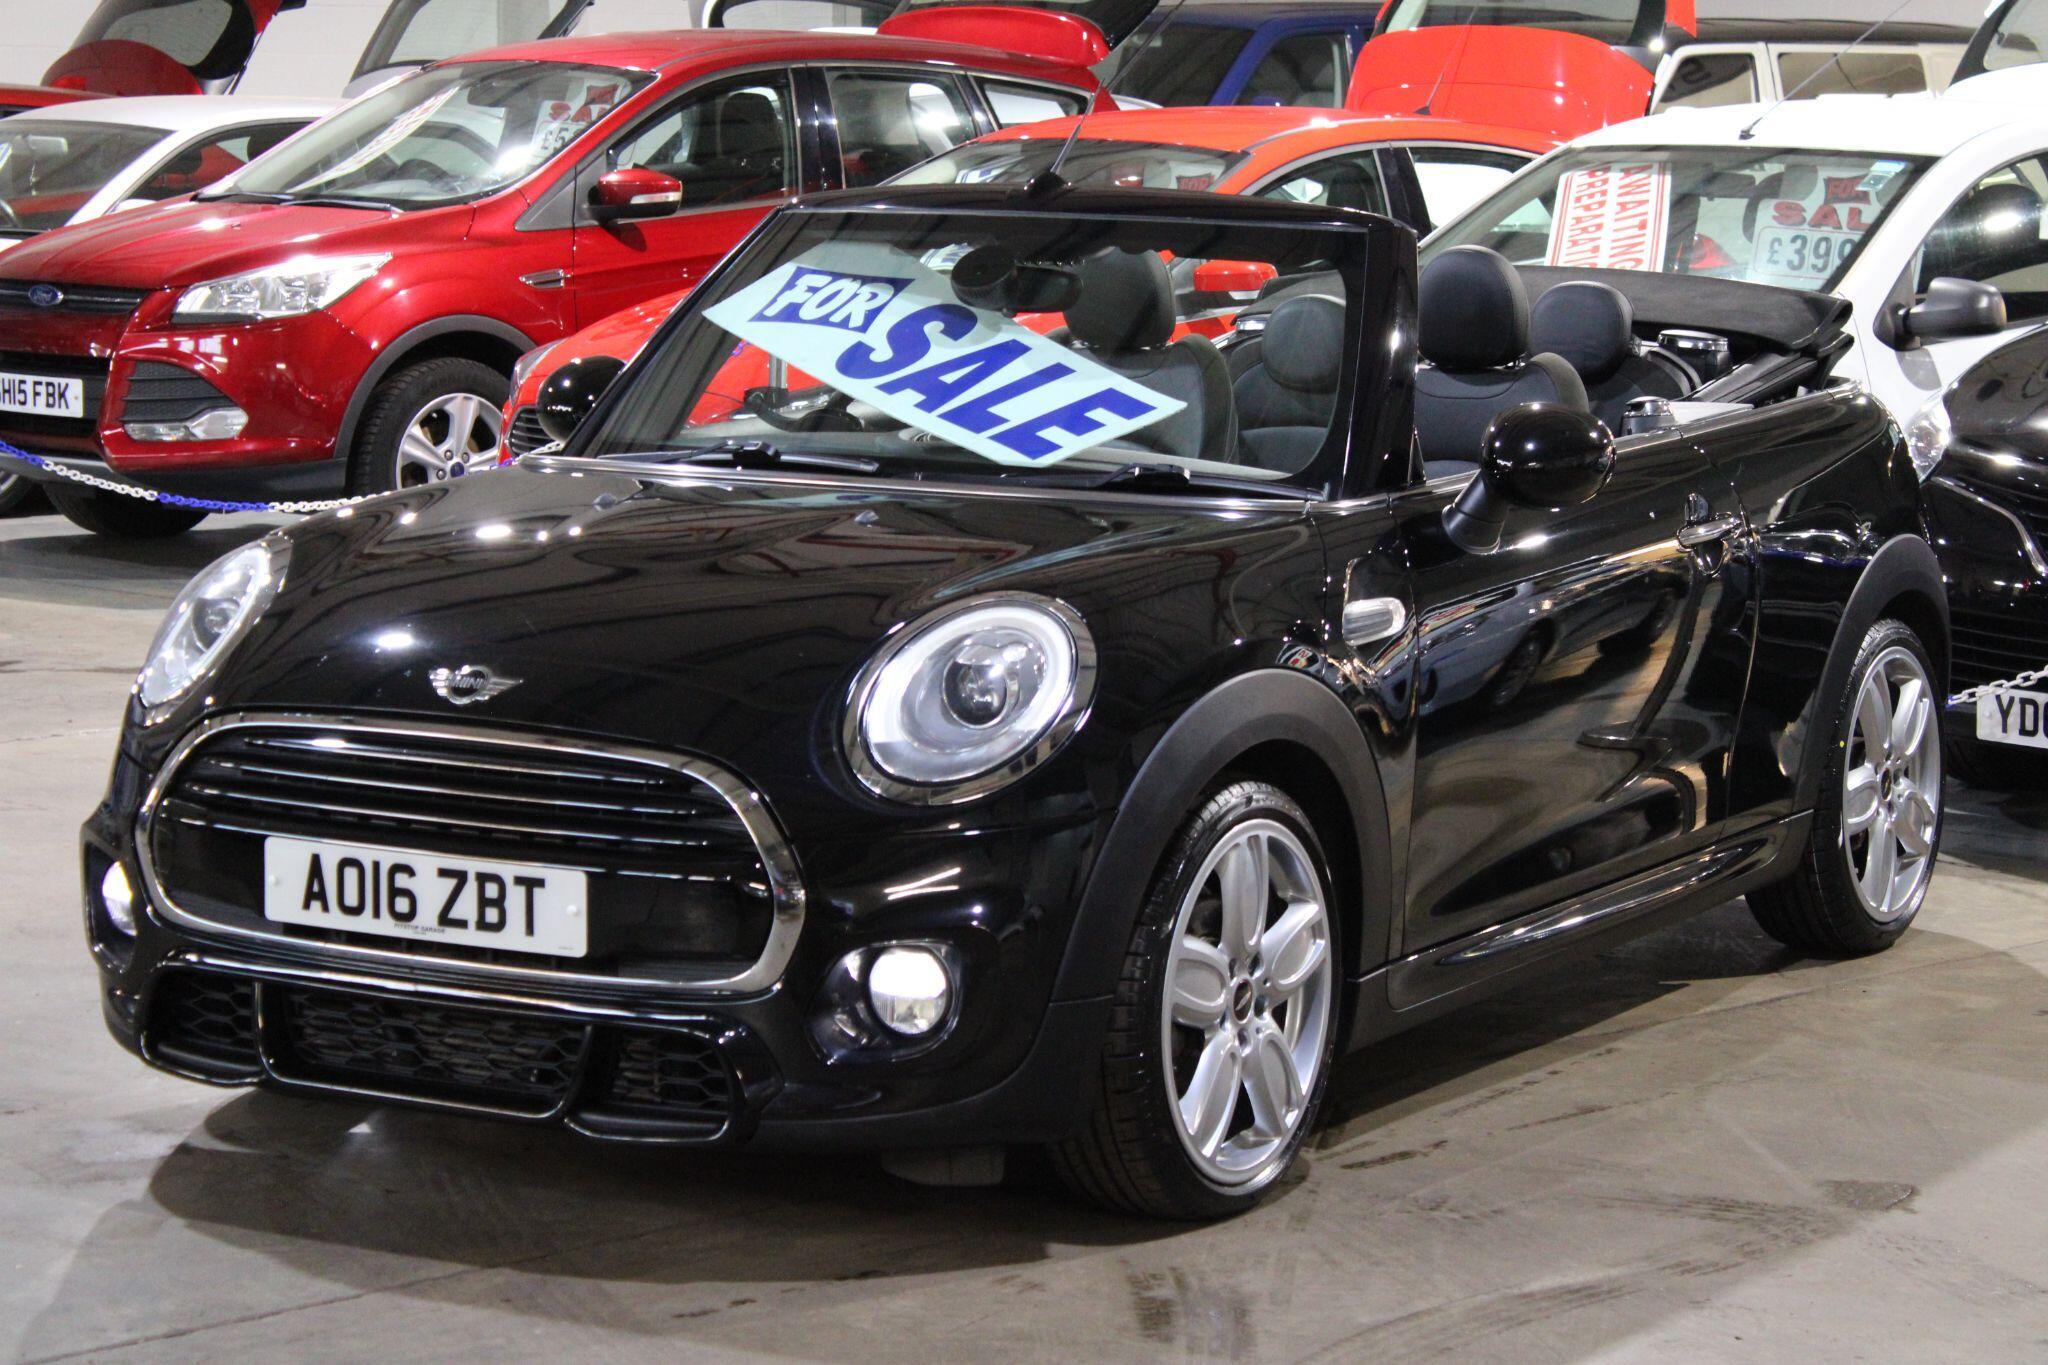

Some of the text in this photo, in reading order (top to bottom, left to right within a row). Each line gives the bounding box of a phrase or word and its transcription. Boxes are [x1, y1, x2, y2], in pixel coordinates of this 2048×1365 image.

[1607, 163, 1654, 269] AWAITING
[0, 378, 69, 409] H15 FBK
[764, 273, 1157, 460] FOR SALE
[1995, 694, 2048, 740] YD
[302, 853, 545, 936] AO16 ZBT
